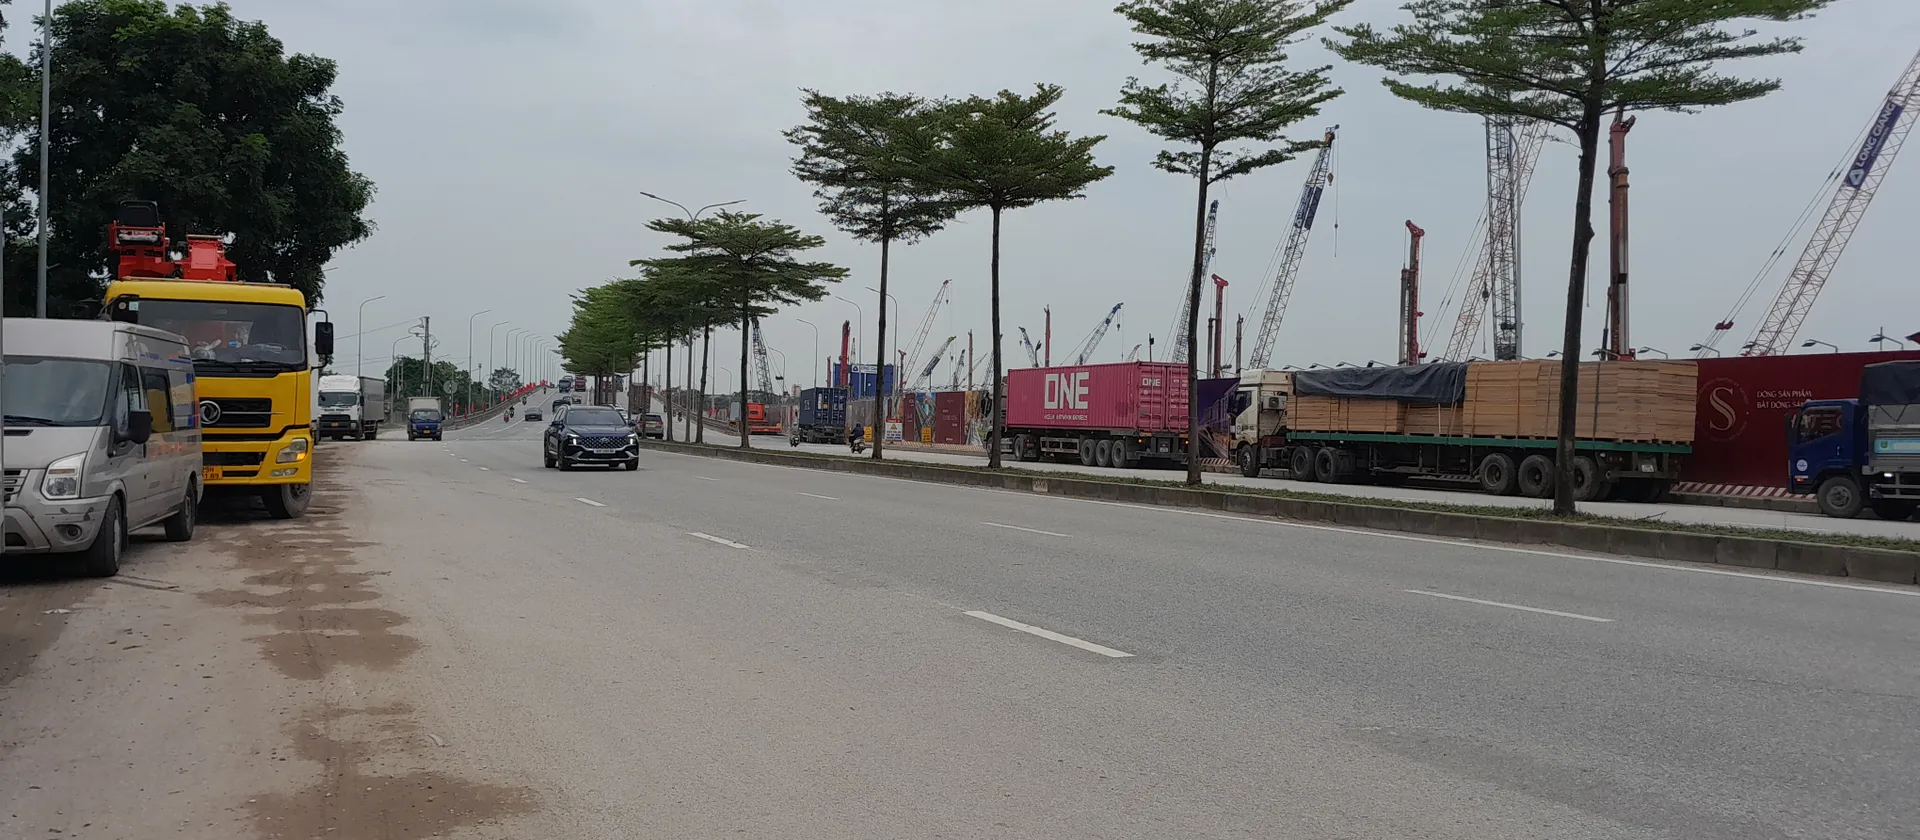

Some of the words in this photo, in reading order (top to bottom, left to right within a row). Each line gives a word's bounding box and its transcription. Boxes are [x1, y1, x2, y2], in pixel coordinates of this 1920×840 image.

[1856, 136, 1877, 168] LONG
[1872, 102, 1897, 137] GIANG
[1044, 371, 1090, 410] ONE
[1142, 377, 1161, 387] ONE
